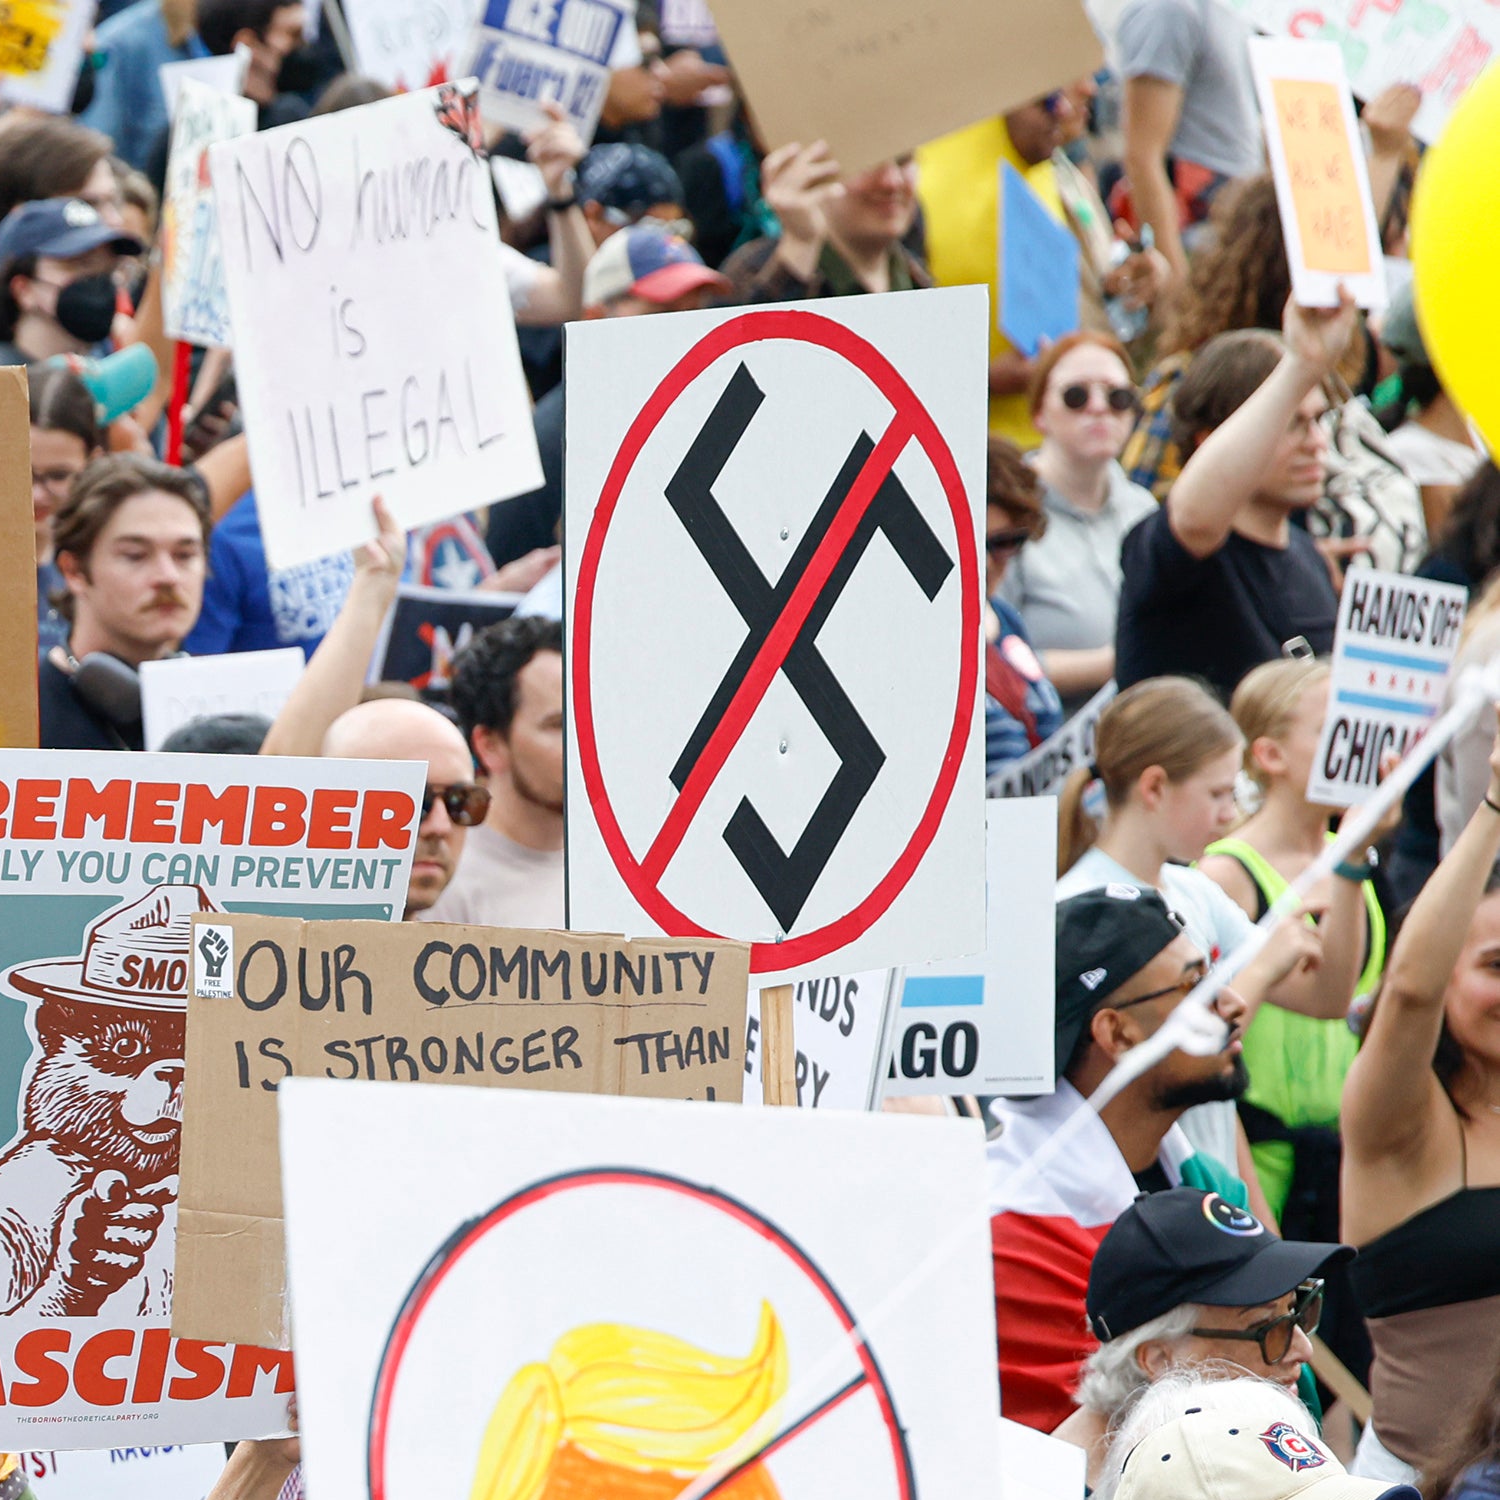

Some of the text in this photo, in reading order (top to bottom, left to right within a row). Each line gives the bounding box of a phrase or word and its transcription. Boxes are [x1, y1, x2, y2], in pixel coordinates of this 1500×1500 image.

[234, 137, 322, 272] NO
[286, 359, 506, 508] ILLEGAL
[1348, 579, 1463, 648] HANDS OFF
[56, 850, 133, 884] YOU
[142, 852, 220, 888] CAN
[231, 855, 402, 890] PREVENT
[116, 954, 189, 992] SMO
[196, 989, 232, 999] PALESTINE
[204, 979, 221, 987] FREE
[237, 939, 715, 1015] OUR COMMUNITY
[234, 1026, 730, 1091] IS STRONGER THAN
[16, 1413, 160, 1424] THEBORINGTHEORETICALPARTY.ORG
